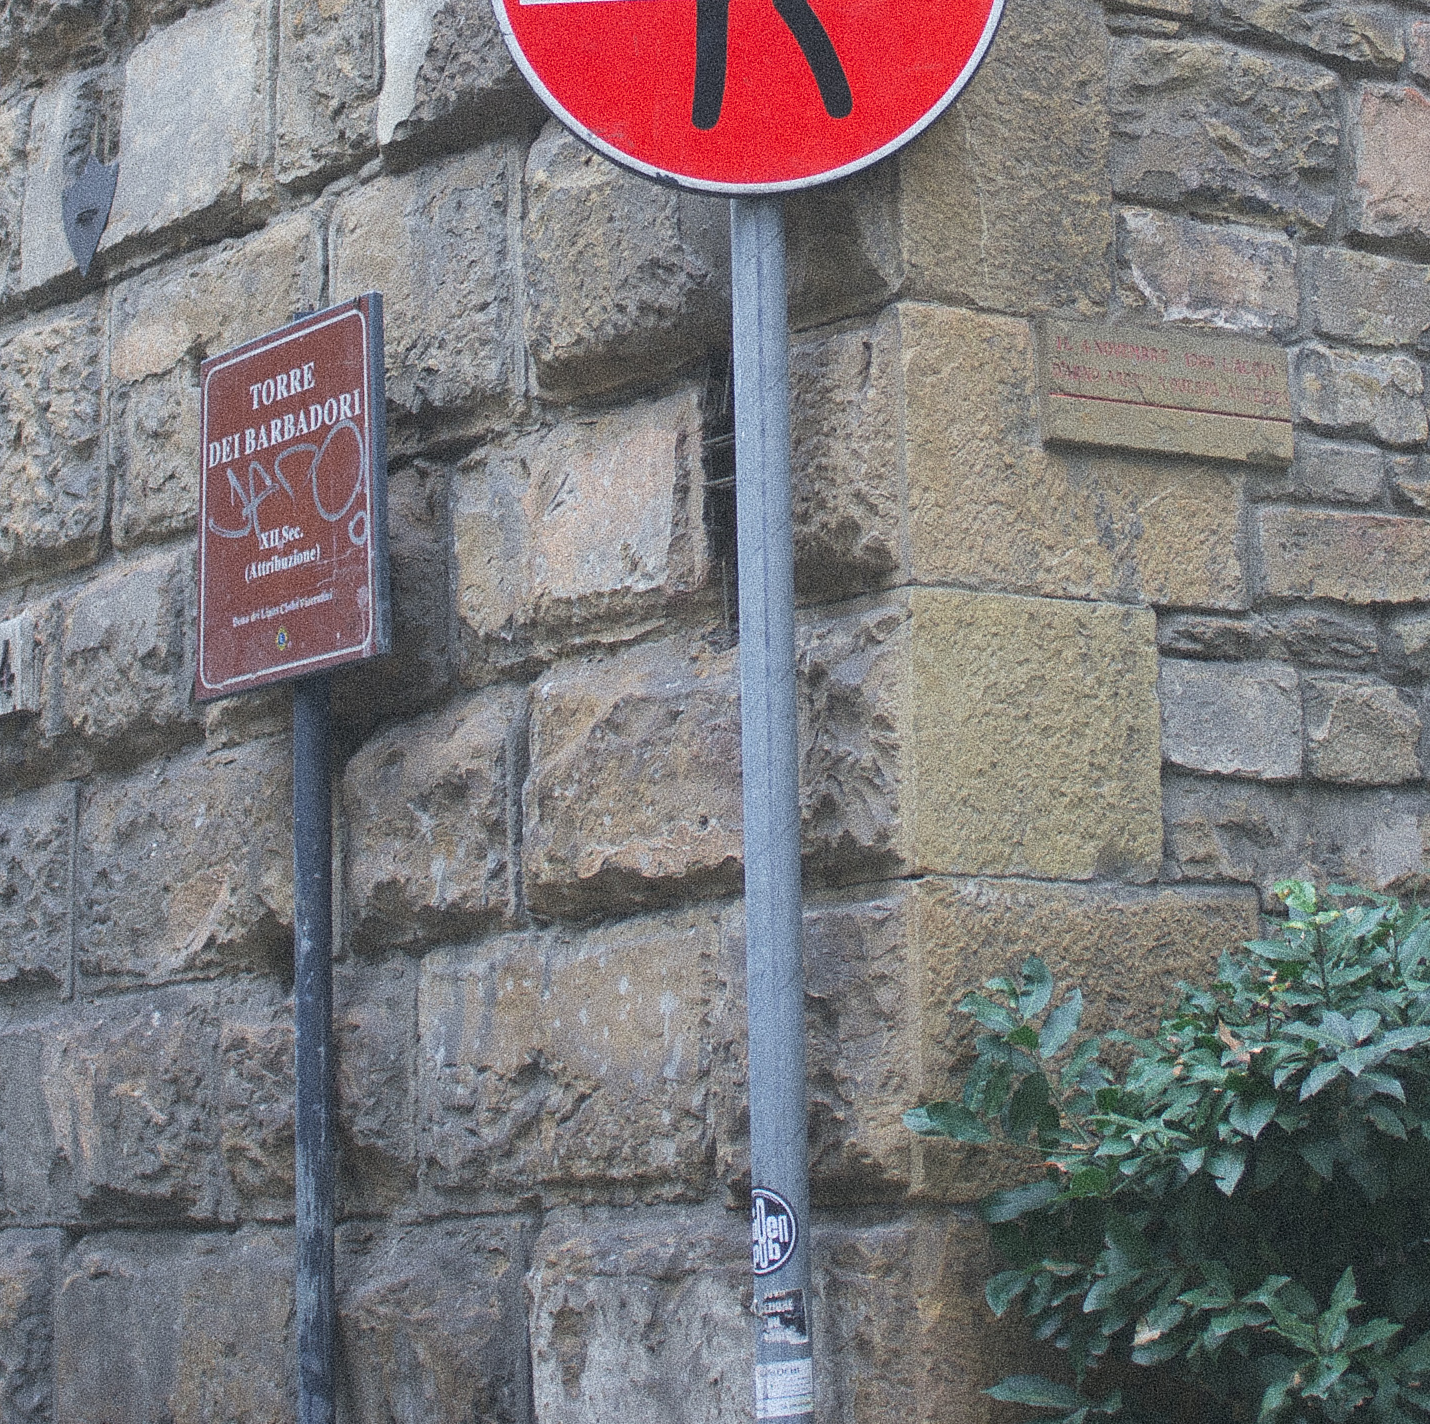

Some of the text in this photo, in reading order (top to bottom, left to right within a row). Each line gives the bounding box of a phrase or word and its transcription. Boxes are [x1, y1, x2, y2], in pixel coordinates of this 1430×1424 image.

[249, 361, 316, 410] TORRE
[208, 388, 362, 469] DEI BARBADORI
[259, 525, 304, 551] XII Sec.
[244, 542, 321, 585] (Attribuzione)
